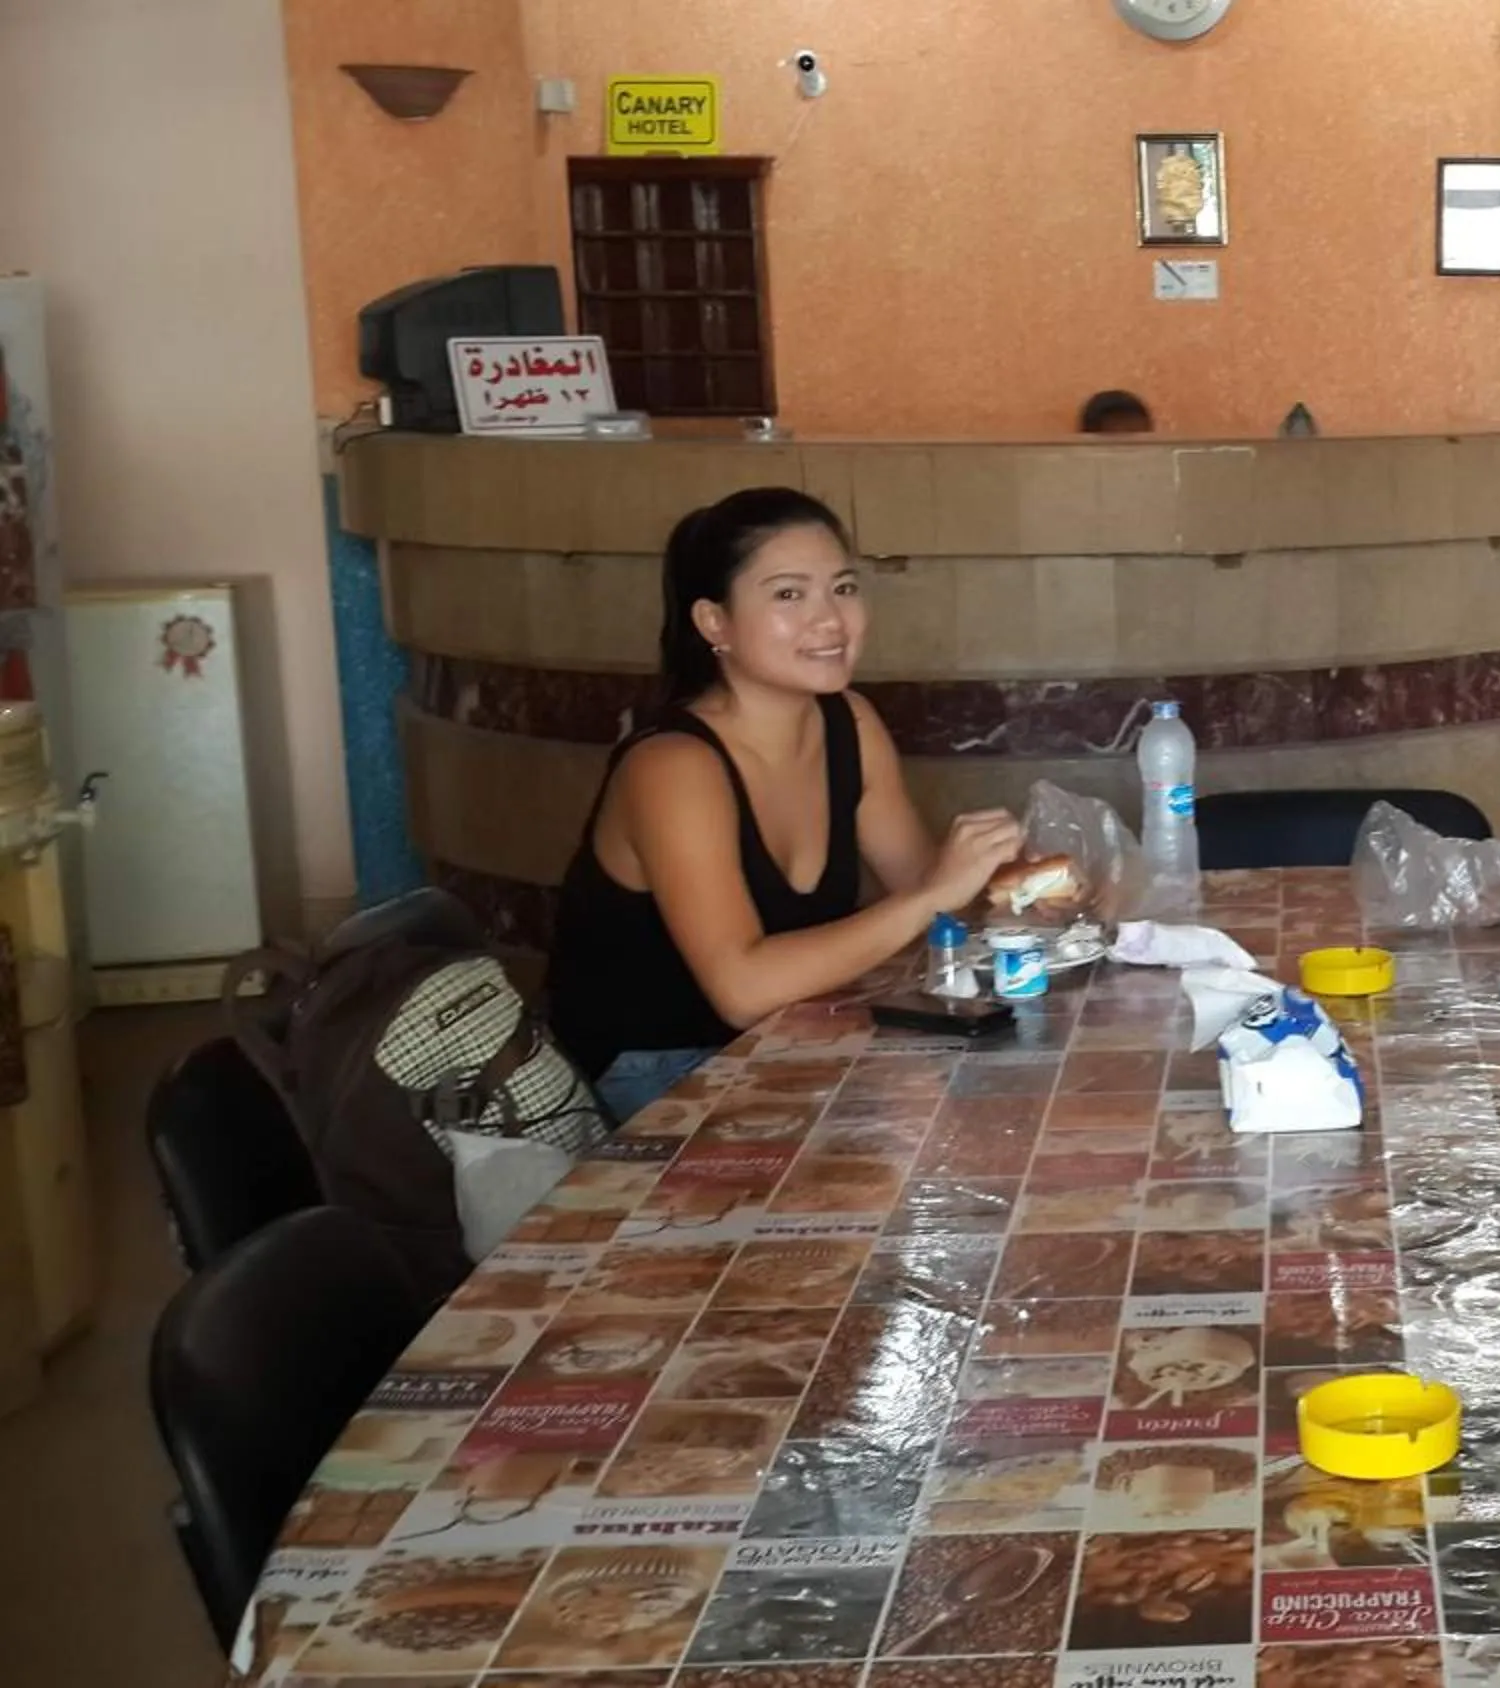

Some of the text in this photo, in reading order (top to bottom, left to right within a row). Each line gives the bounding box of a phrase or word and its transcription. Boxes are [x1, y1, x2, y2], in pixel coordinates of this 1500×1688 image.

[617, 91, 706, 115] CANARY
[628, 119, 692, 135] HOTEL
[464, 346, 596, 385] المغادرة
[1272, 1590, 1421, 1611] FRAPPUCCINO
[1264, 1606, 1433, 1632] Java Chip
[1084, 1660, 1222, 1676] BROWNIES
